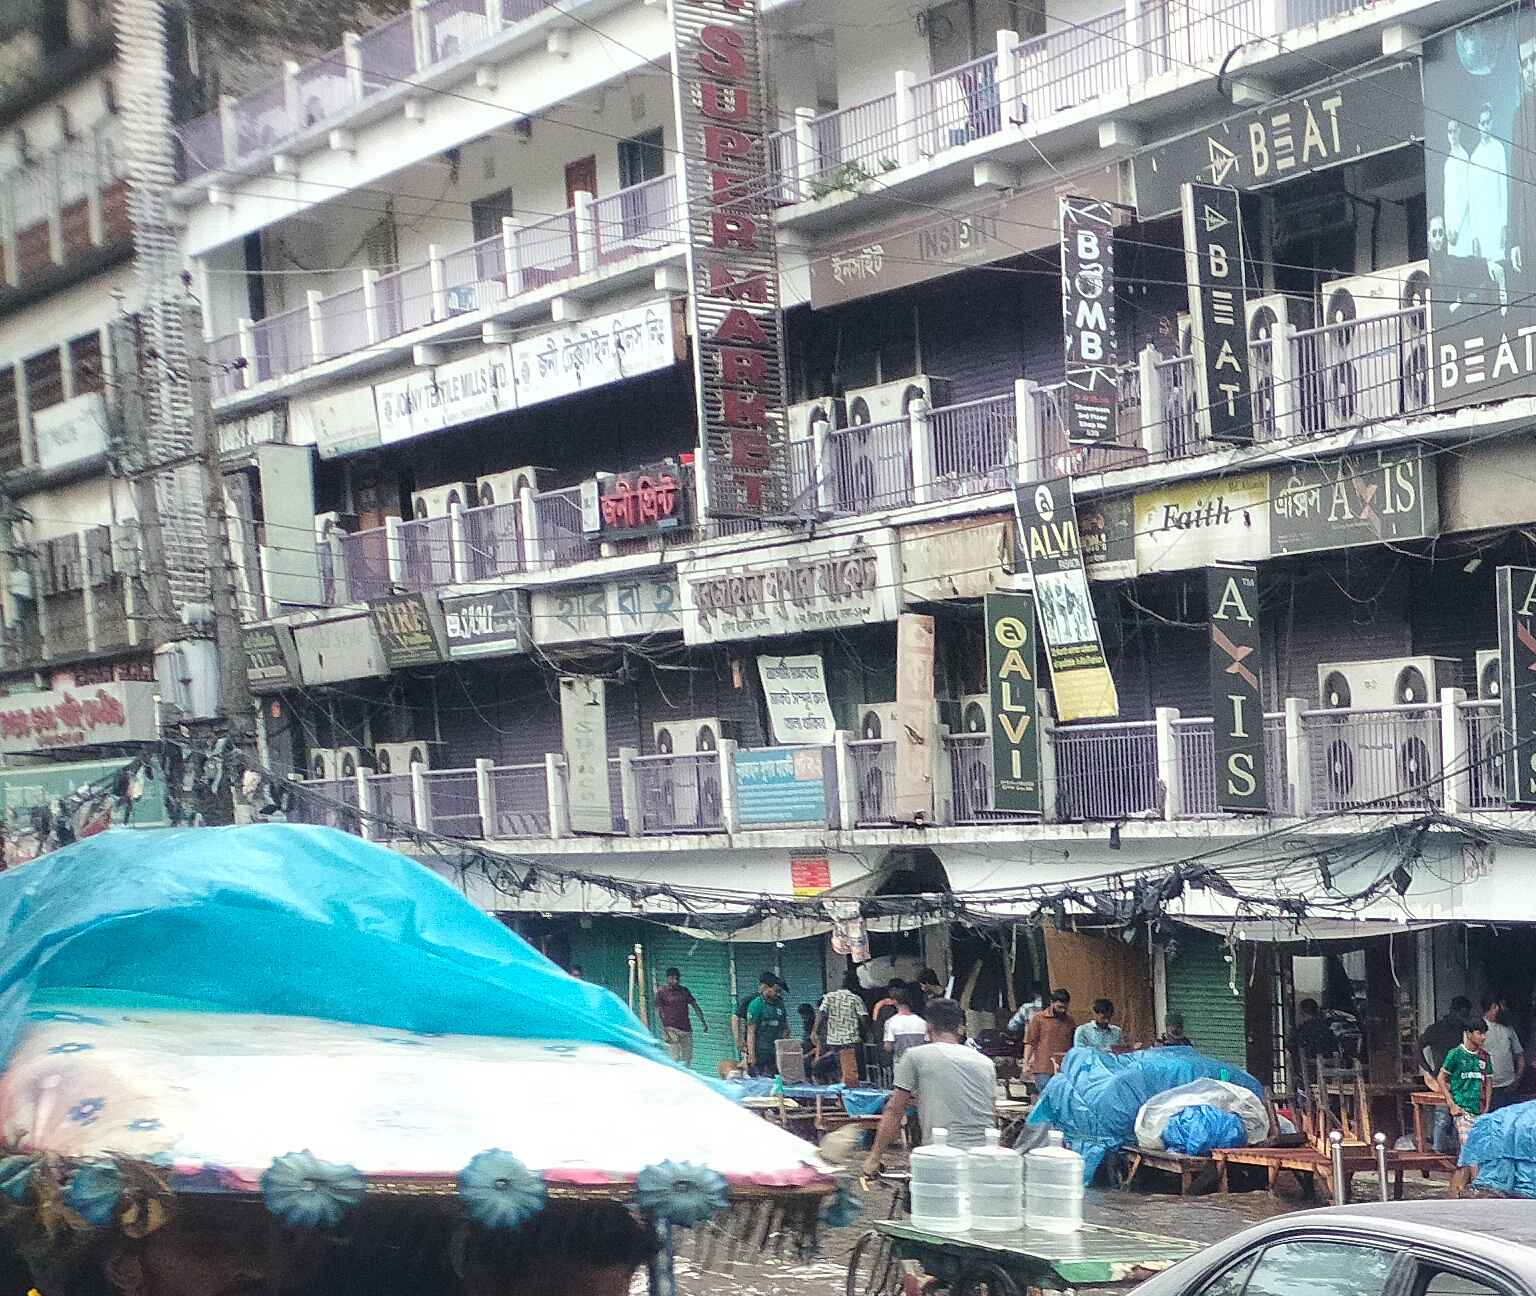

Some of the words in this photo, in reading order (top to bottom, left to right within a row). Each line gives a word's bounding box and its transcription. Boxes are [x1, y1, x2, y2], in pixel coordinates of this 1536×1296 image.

[1248, 96, 1345, 178] BEAT
[1207, 243, 1240, 419] BEAT
[1029, 521, 1078, 560] ALVI
[1162, 496, 1233, 532] Faith
[998, 650, 1032, 779] ALVI
[1211, 574, 1257, 797] AXIS
